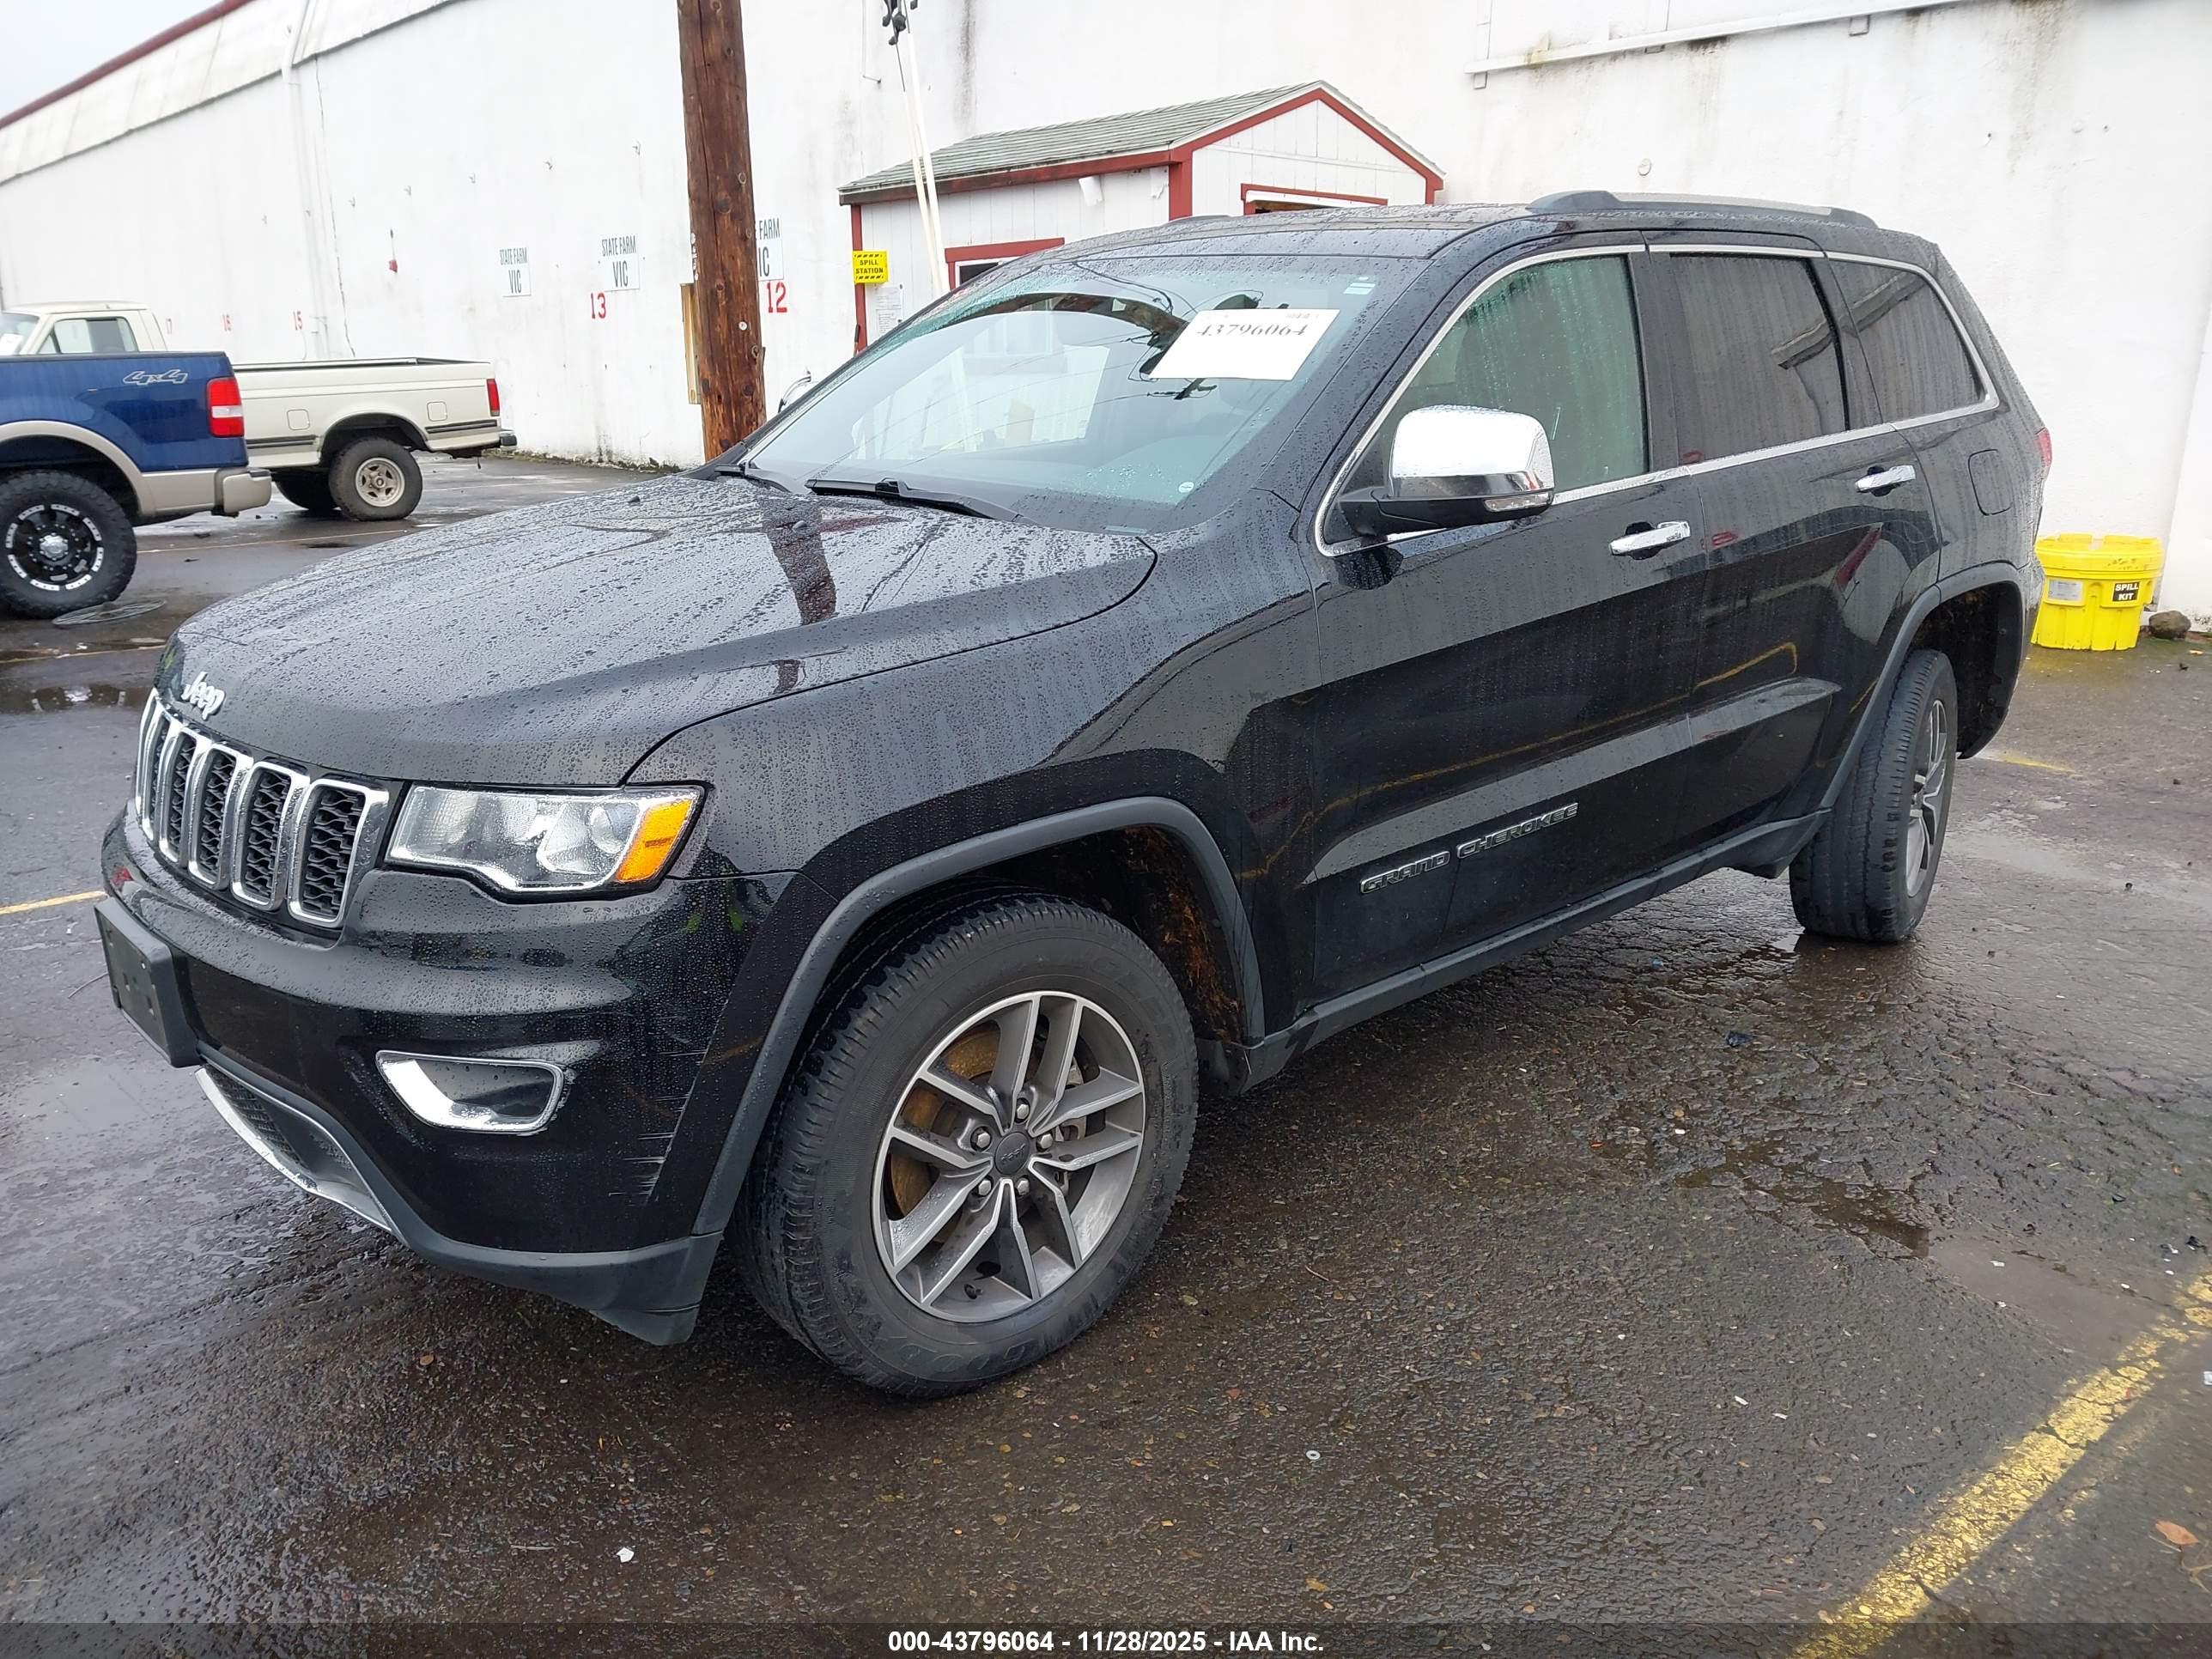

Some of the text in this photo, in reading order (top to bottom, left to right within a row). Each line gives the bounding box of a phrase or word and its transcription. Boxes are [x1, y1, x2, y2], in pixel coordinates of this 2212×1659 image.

[758, 218, 781, 240] FARM
[499, 247, 528, 266] STATE FARM
[602, 235, 636, 257] STATE FARM
[758, 246, 770, 277] IC
[508, 270, 522, 295] VIC
[612, 260, 629, 288] VIC
[590, 292, 607, 319] 13
[767, 282, 787, 313] 12
[1196, 323, 1310, 337] 43796064
[123, 368, 189, 386] 4x4
[2115, 583, 2139, 592] SPILL
[2118, 592, 2135, 601] KIT
[180, 671, 227, 722] Jeep
[1360, 802, 1579, 894] GRAND CHEROKEE
